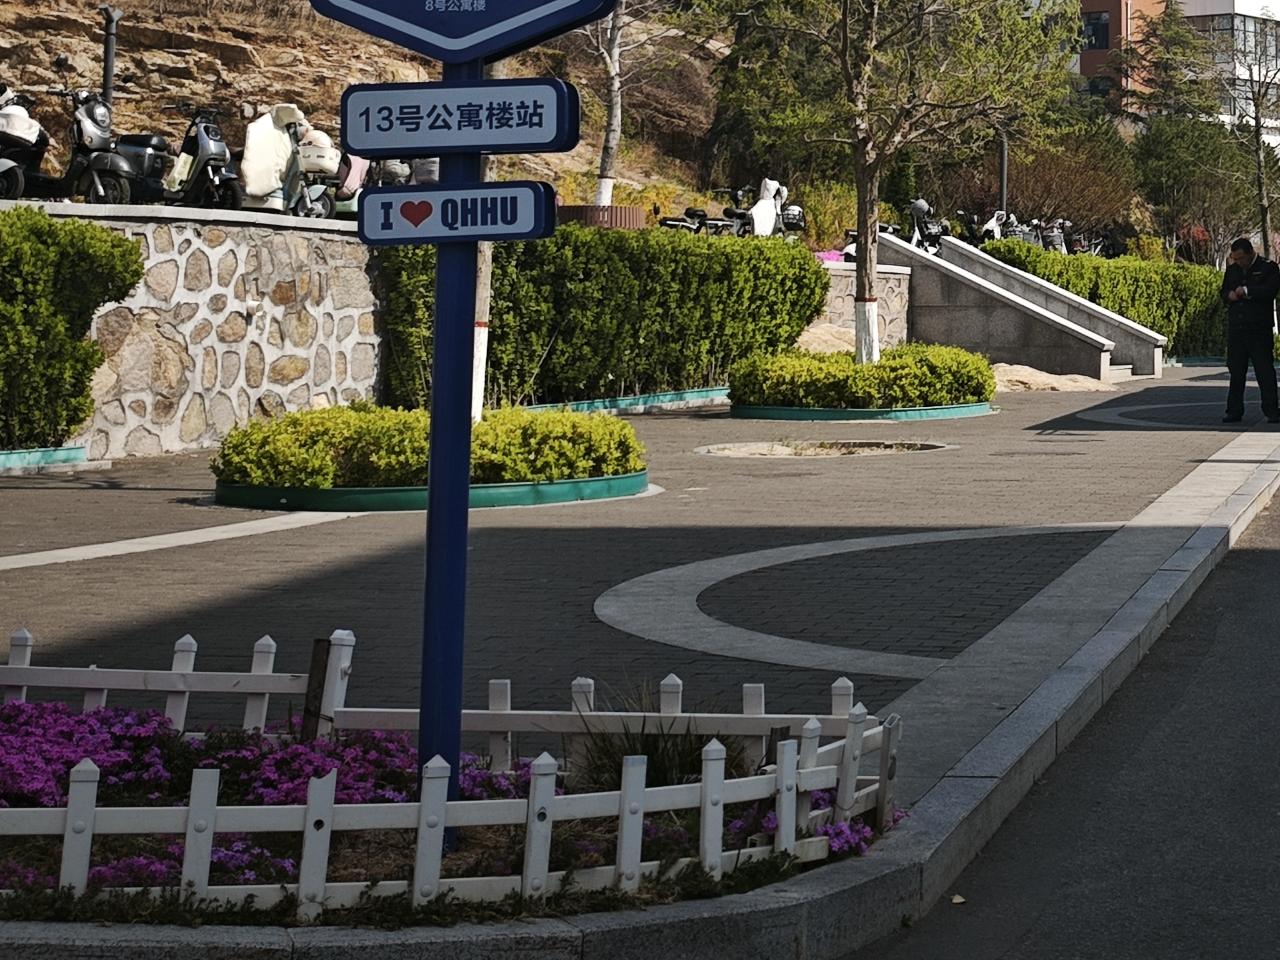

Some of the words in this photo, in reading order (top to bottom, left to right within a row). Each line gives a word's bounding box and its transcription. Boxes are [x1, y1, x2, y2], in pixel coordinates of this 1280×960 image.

[425, 0, 486, 12] 8号公寓楼
[358, 100, 545, 133] 13号公寓楼站
[380, 201, 393, 230] I
[441, 196, 519, 230] QHHU
